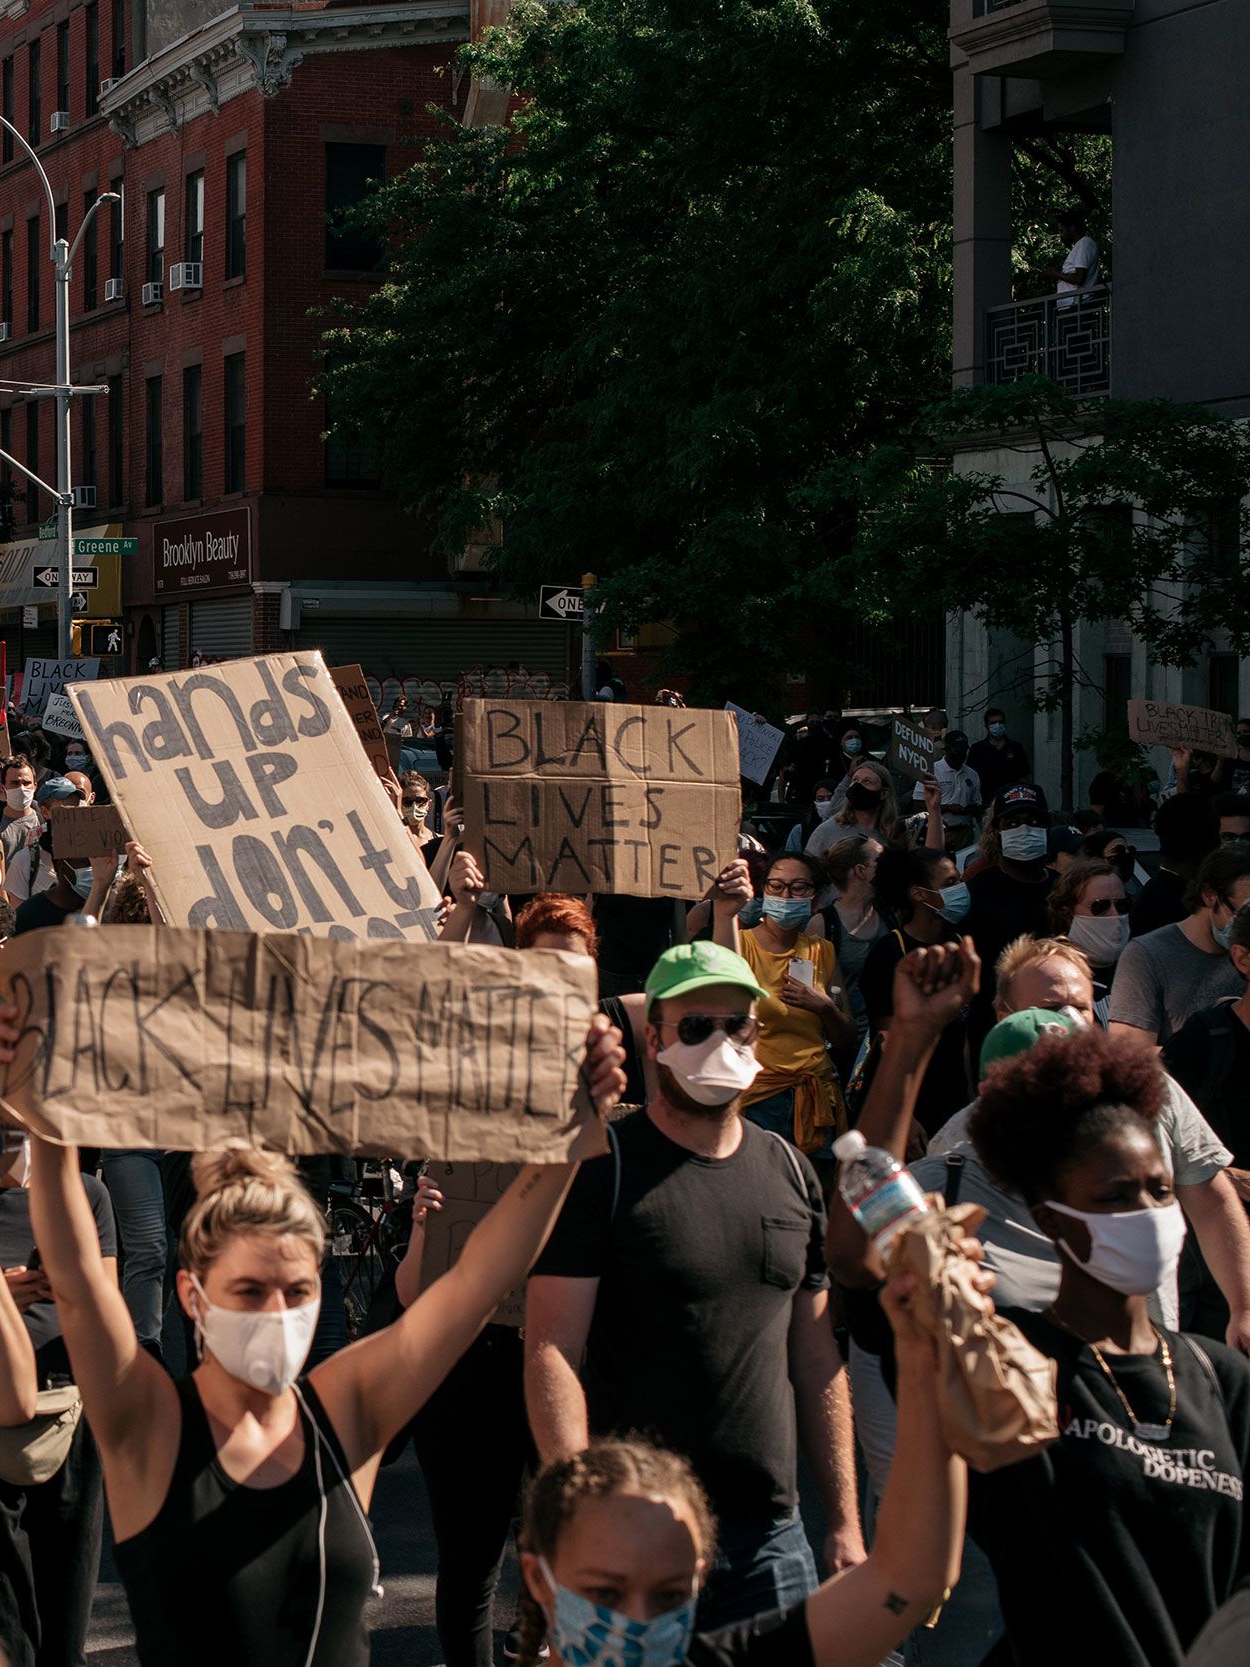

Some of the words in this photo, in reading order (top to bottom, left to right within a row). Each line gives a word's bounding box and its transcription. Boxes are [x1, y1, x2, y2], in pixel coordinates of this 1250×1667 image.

[78, 540, 119, 553] Greene
[123, 540, 133, 549] Av
[163, 534, 204, 571] Brooklyn
[206, 530, 239, 565] Beauty
[45, 571, 58, 582] ON
[29, 680, 67, 696] LIVE
[31, 661, 86, 678] BLACK
[46, 714, 85, 734] BREONN
[76, 659, 332, 780] hands
[1145, 704, 1194, 721] BLACK
[487, 710, 703, 776] BLACK
[895, 720, 934, 754] DEFUND
[899, 744, 928, 773] NYPD
[484, 783, 664, 829] LIVES
[188, 810, 421, 930] don't
[483, 836, 720, 892] MATTER
[3, 960, 202, 1099] BLACK
[224, 975, 401, 1116] LIVES
[414, 979, 595, 1119] MATTER
[1144, 1458, 1243, 1501] DOPENESS
